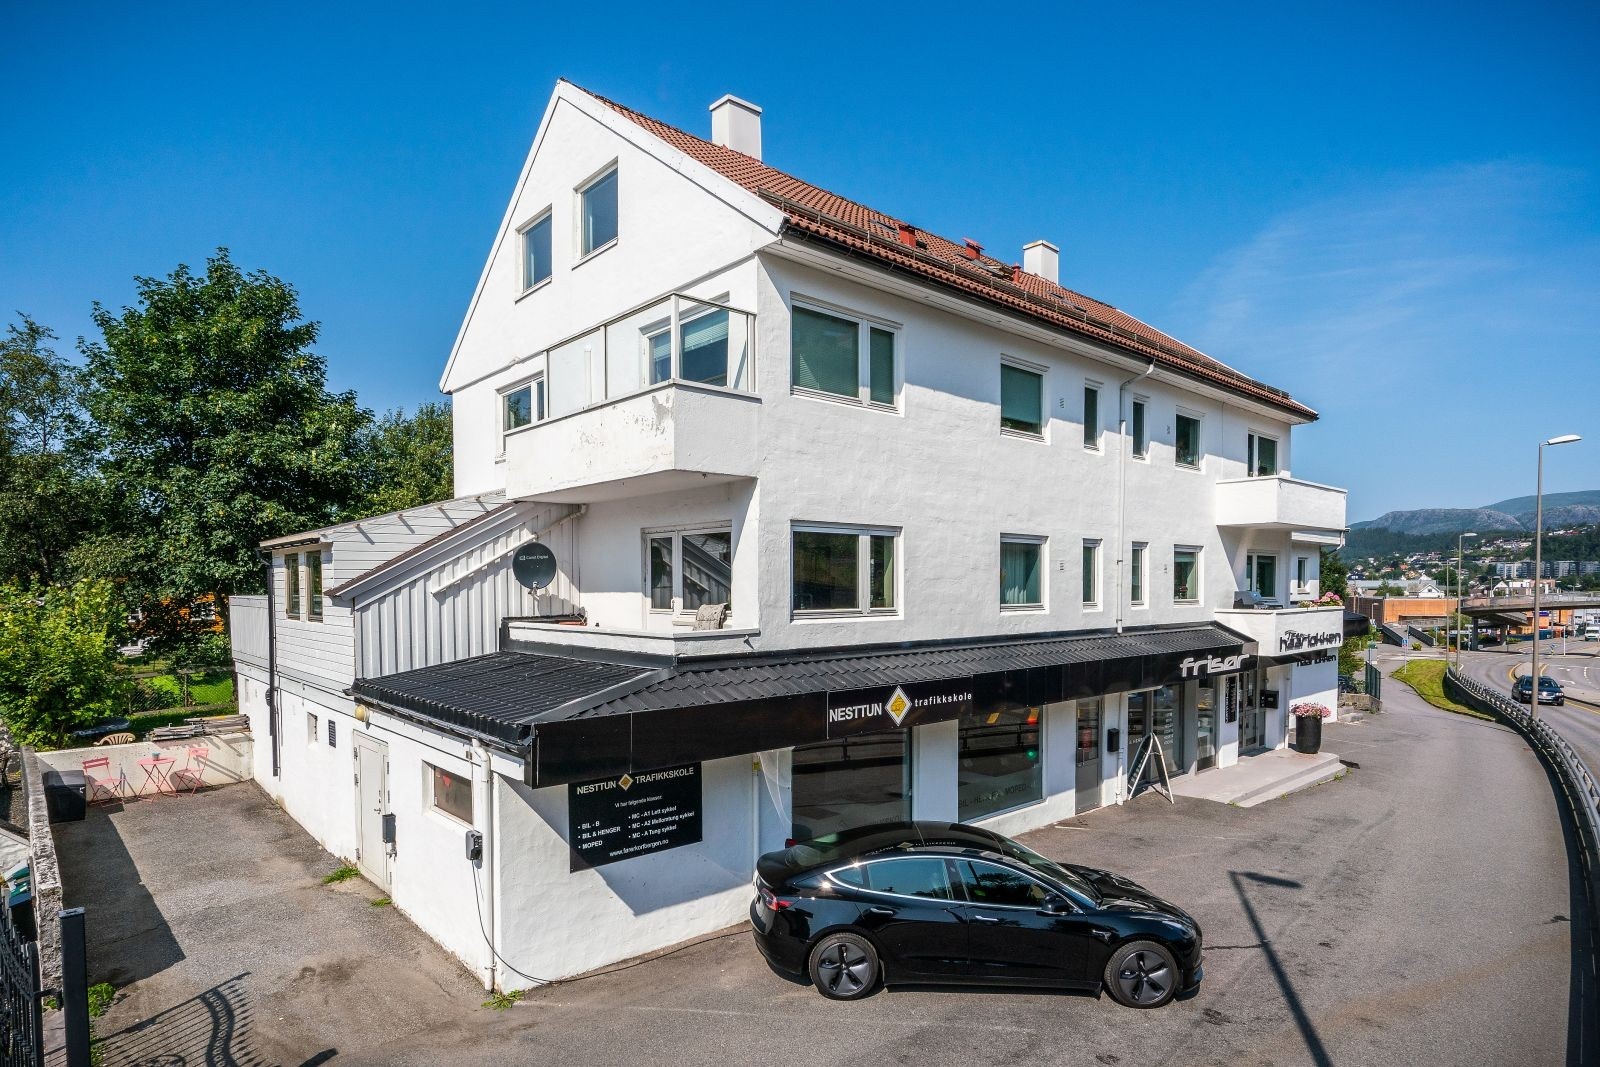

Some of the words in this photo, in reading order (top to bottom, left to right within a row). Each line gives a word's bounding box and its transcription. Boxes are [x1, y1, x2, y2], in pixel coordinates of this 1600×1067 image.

[1179, 653, 1250, 678] frisør
[829, 702, 882, 723] NESTTUN
[914, 692, 973, 707] trafikkskole
[576, 780, 617, 795] NESTTUN
[635, 767, 695, 784] TRAFIKKSKOLE
[661, 805, 677, 814] sykkel
[679, 811, 695, 820] sykkel
[597, 825, 621, 836] HENGER
[661, 824, 677, 833] sykkel
[581, 840, 603, 850] MOPED
